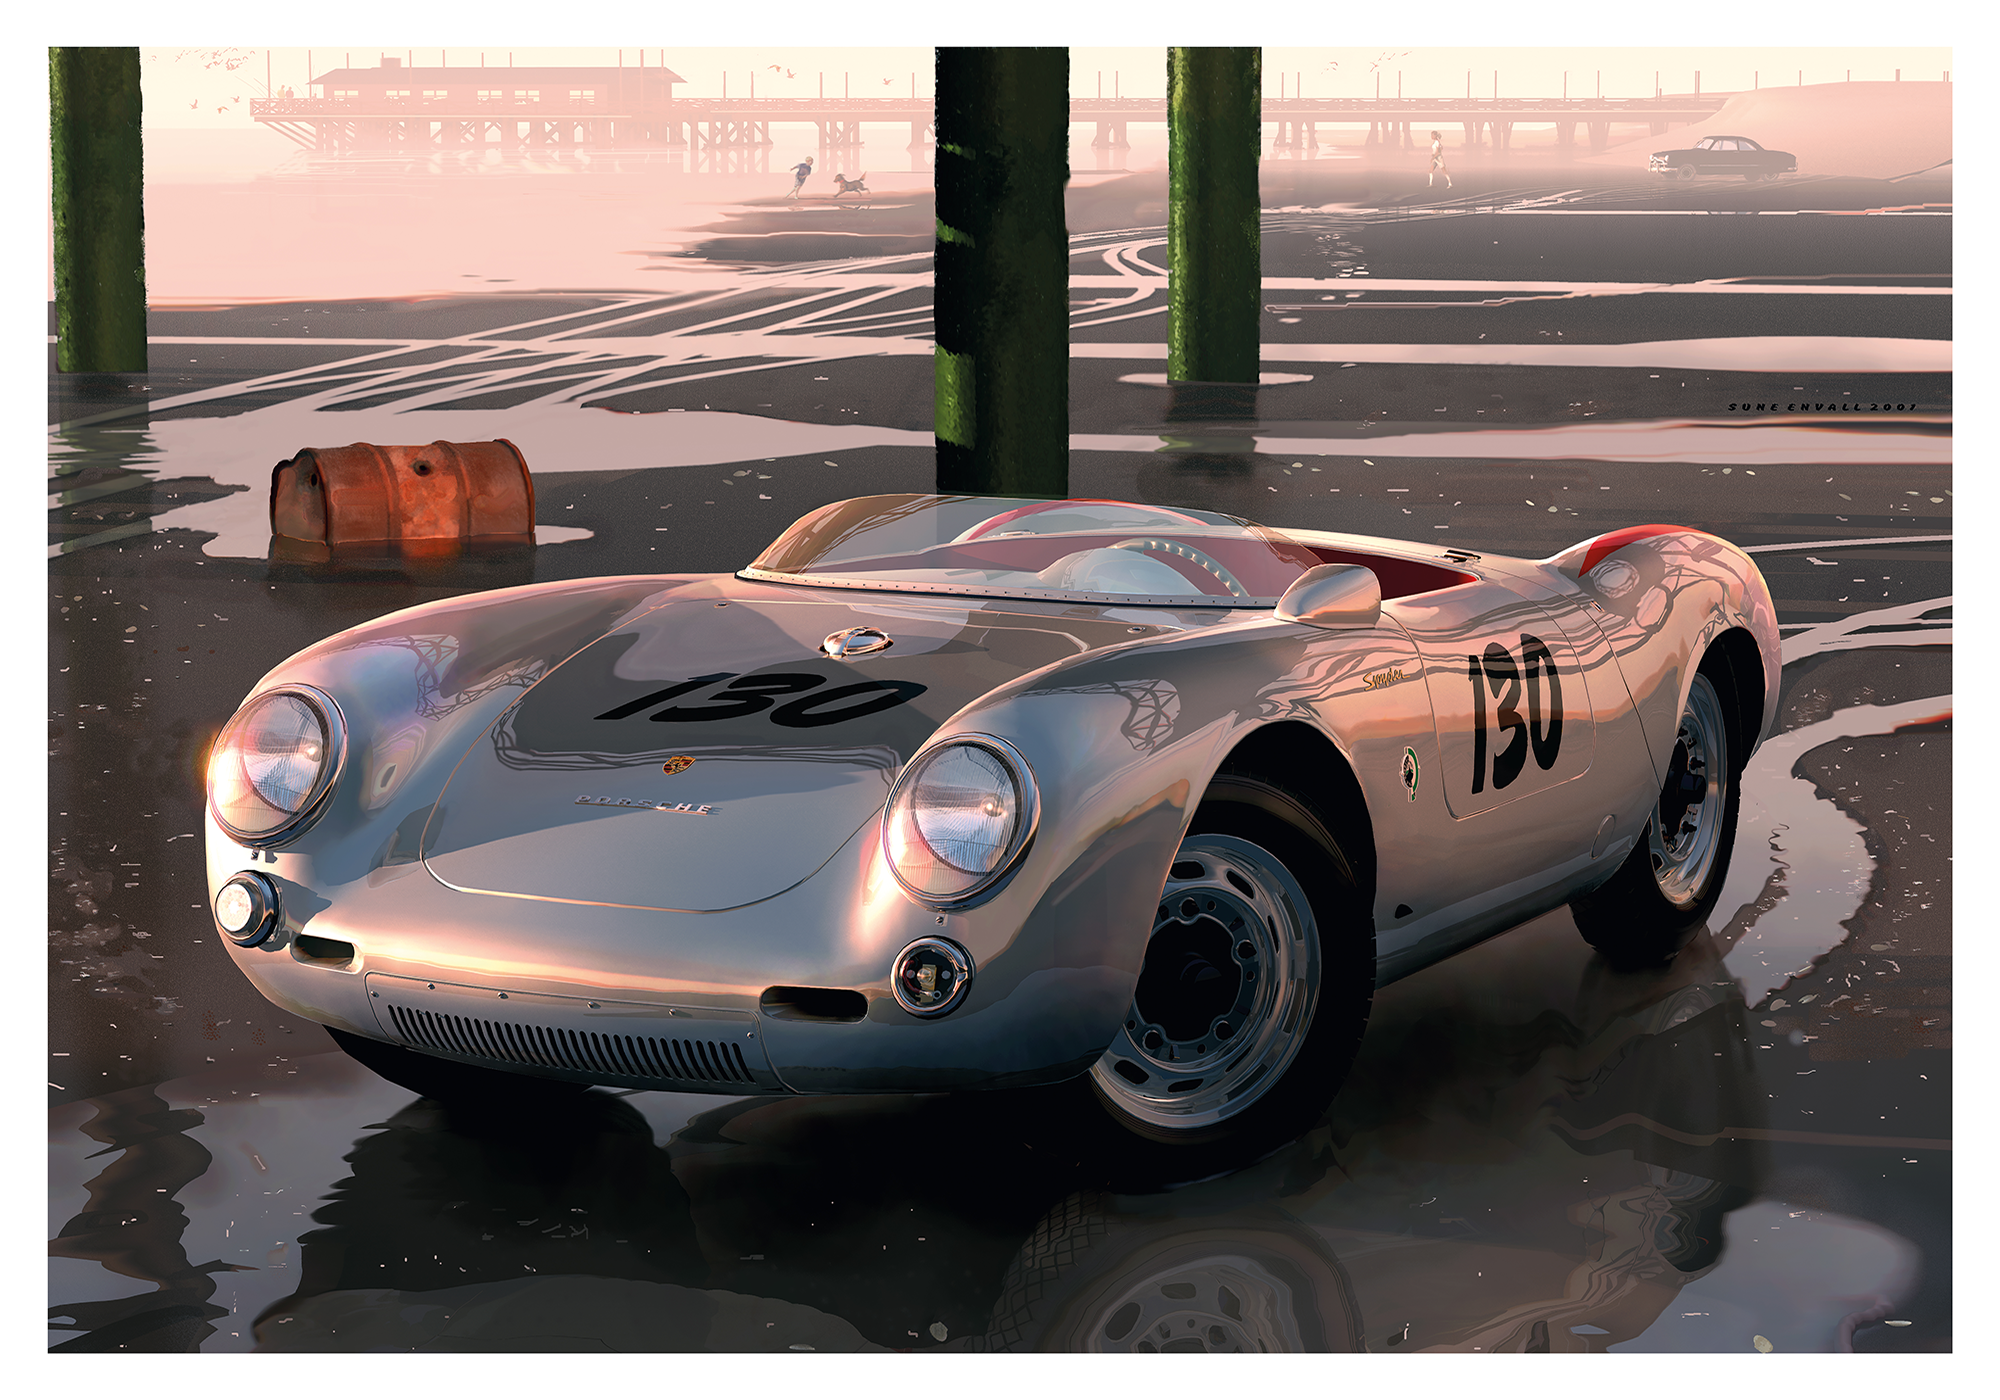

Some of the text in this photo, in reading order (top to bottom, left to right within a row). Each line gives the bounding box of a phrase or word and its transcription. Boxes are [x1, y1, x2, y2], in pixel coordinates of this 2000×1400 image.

[1363, 667, 1410, 691] Spyder
[593, 672, 928, 728] 130
[1469, 633, 1563, 794] 130
[575, 795, 712, 816] PORSCHE
